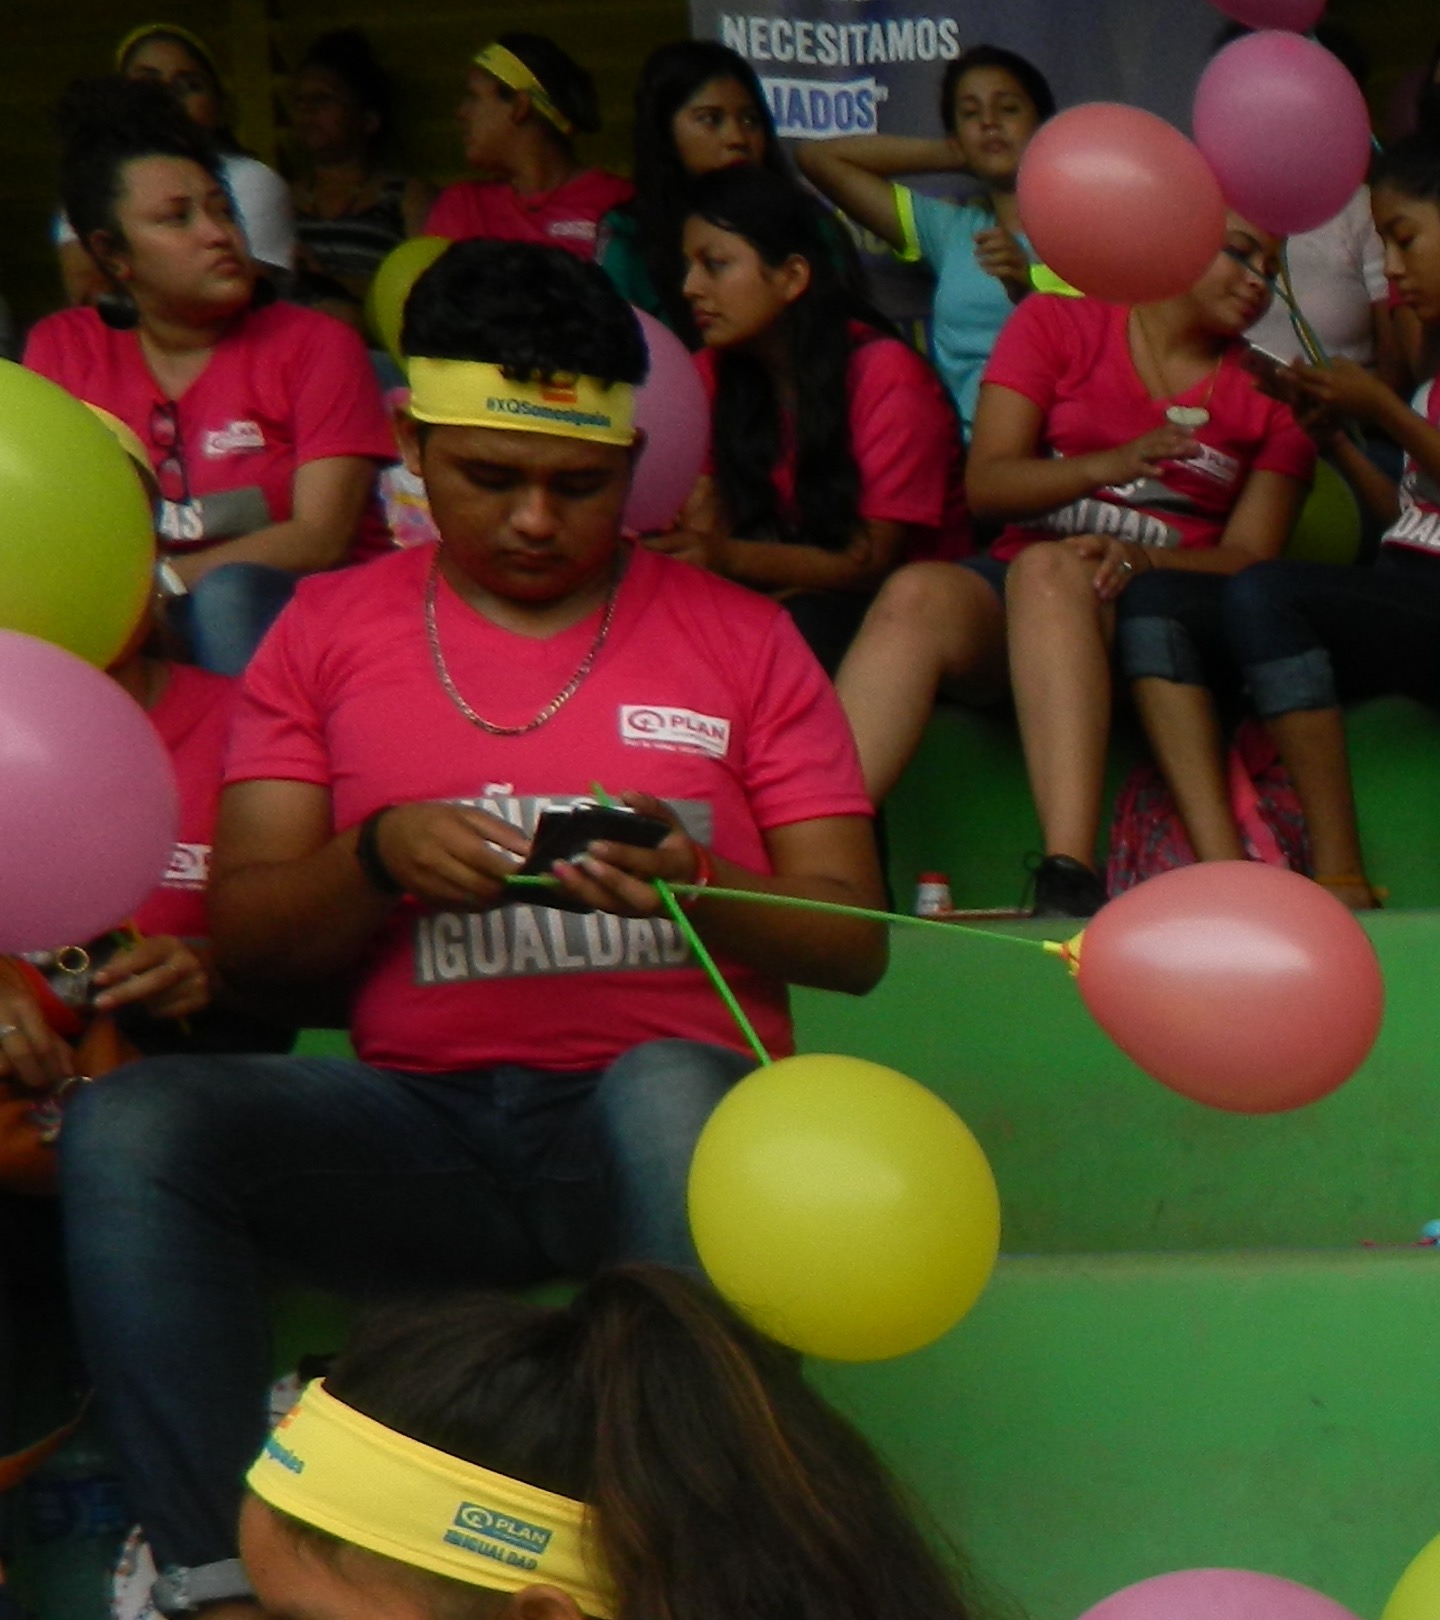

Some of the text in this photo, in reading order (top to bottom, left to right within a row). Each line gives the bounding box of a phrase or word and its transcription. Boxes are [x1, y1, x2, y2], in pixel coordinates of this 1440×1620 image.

[721, 14, 960, 66] NECESITAMOS
[671, 714, 725, 740] PLAN
[416, 902, 692, 983] IGUALDAD
[495, 1518, 547, 1545] PLAN
